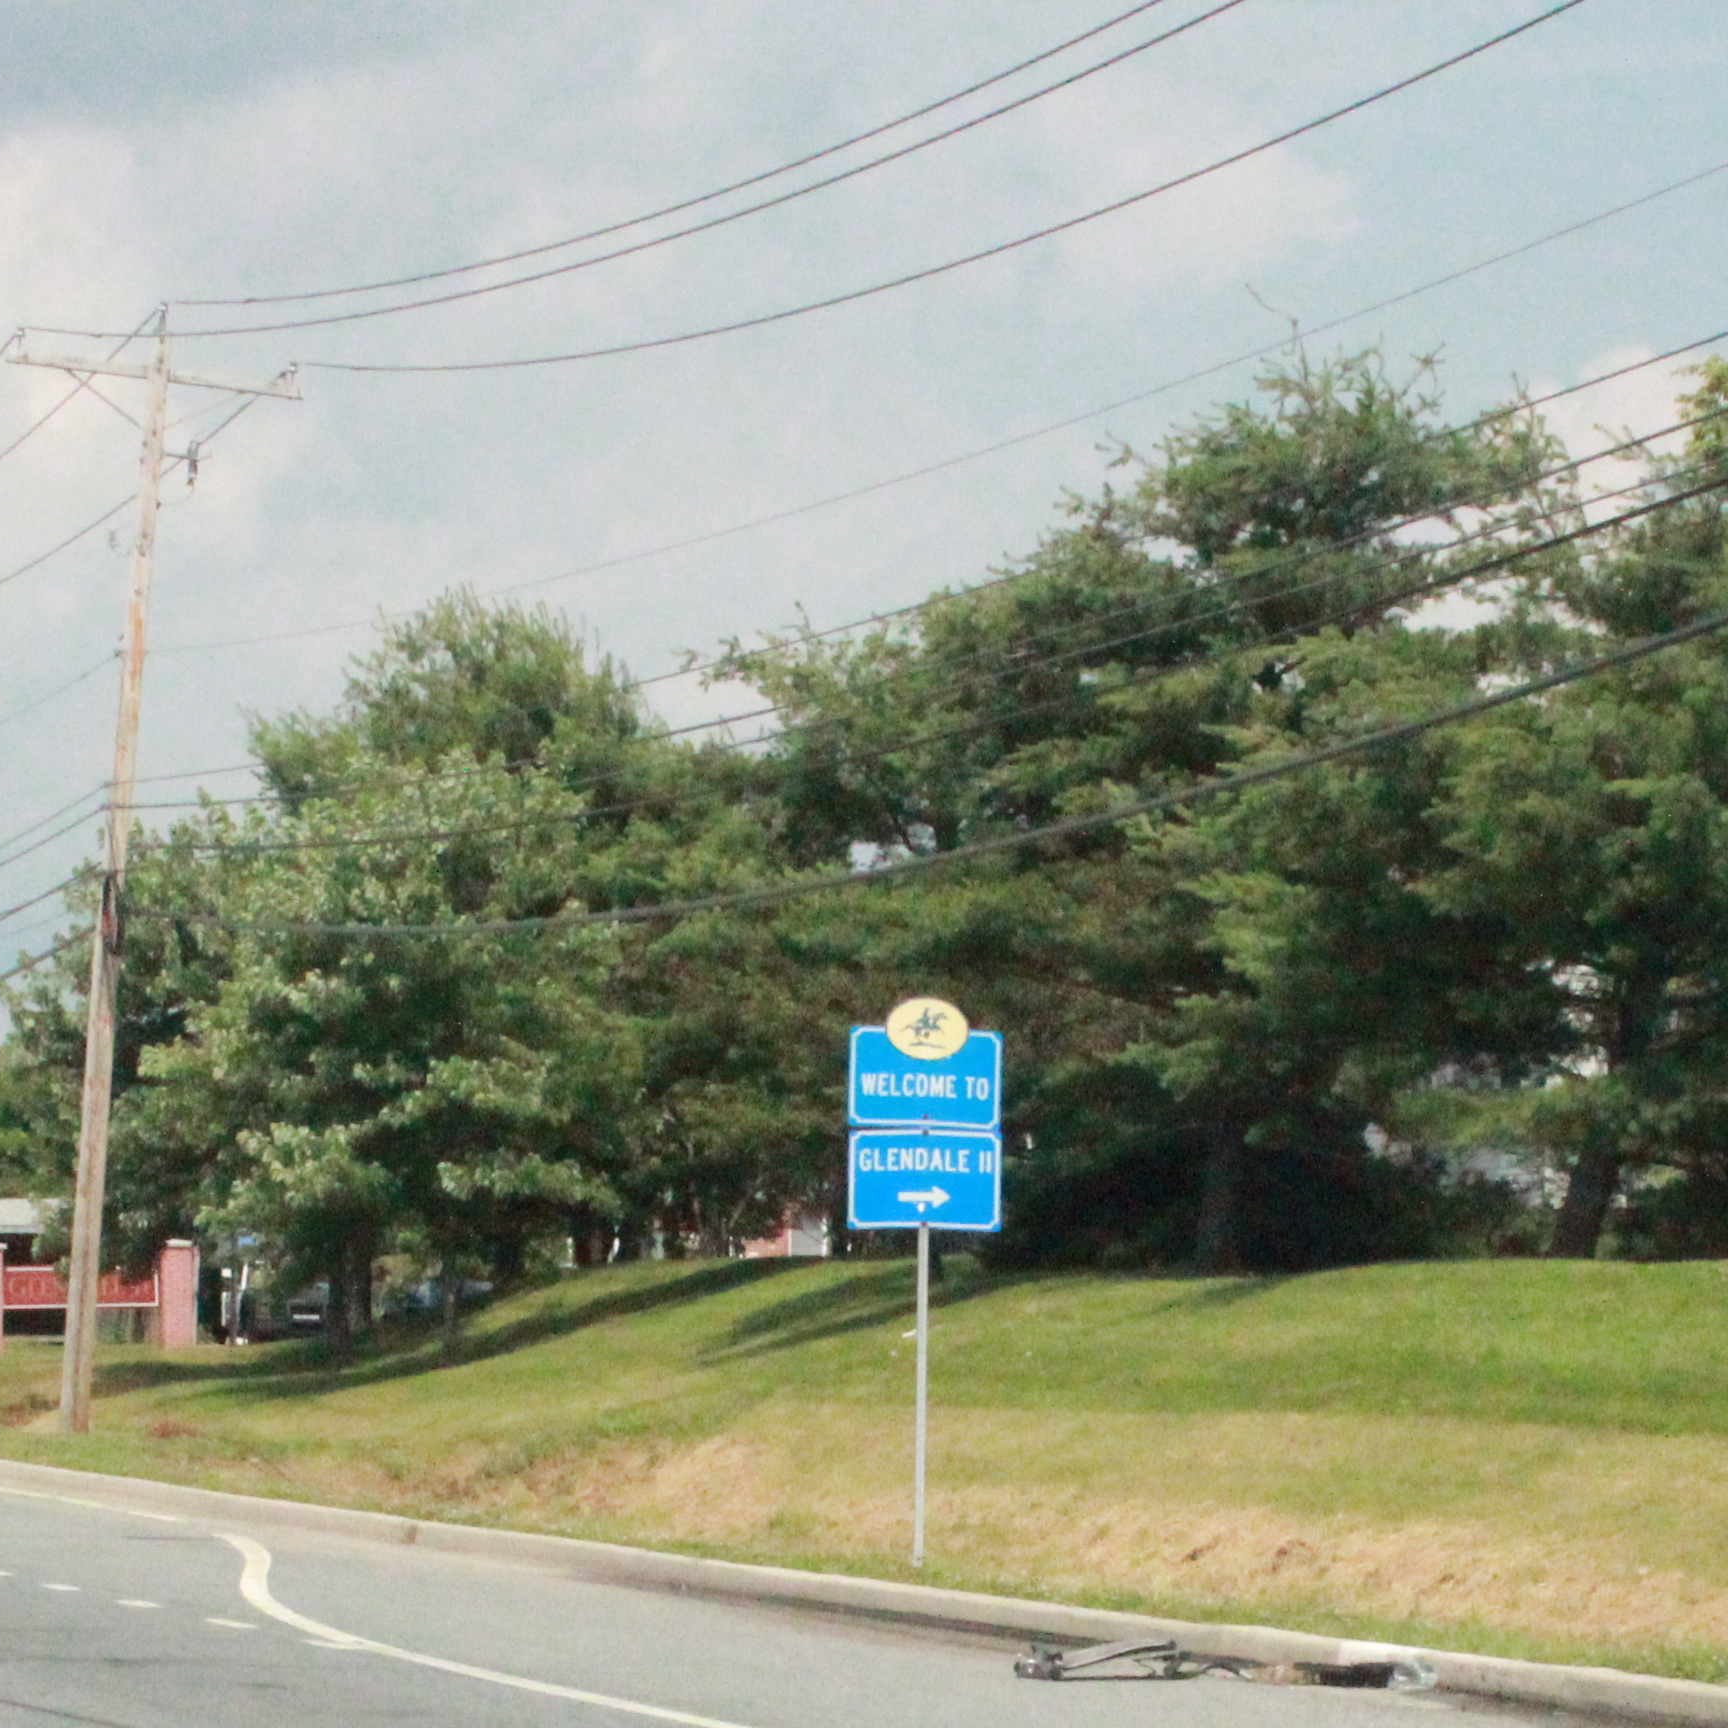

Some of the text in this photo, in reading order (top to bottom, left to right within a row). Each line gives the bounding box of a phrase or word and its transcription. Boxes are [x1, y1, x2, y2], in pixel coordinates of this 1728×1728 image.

[860, 1073, 990, 1101] WELCOME TO
[859, 1148, 970, 1173] GLENDALE
